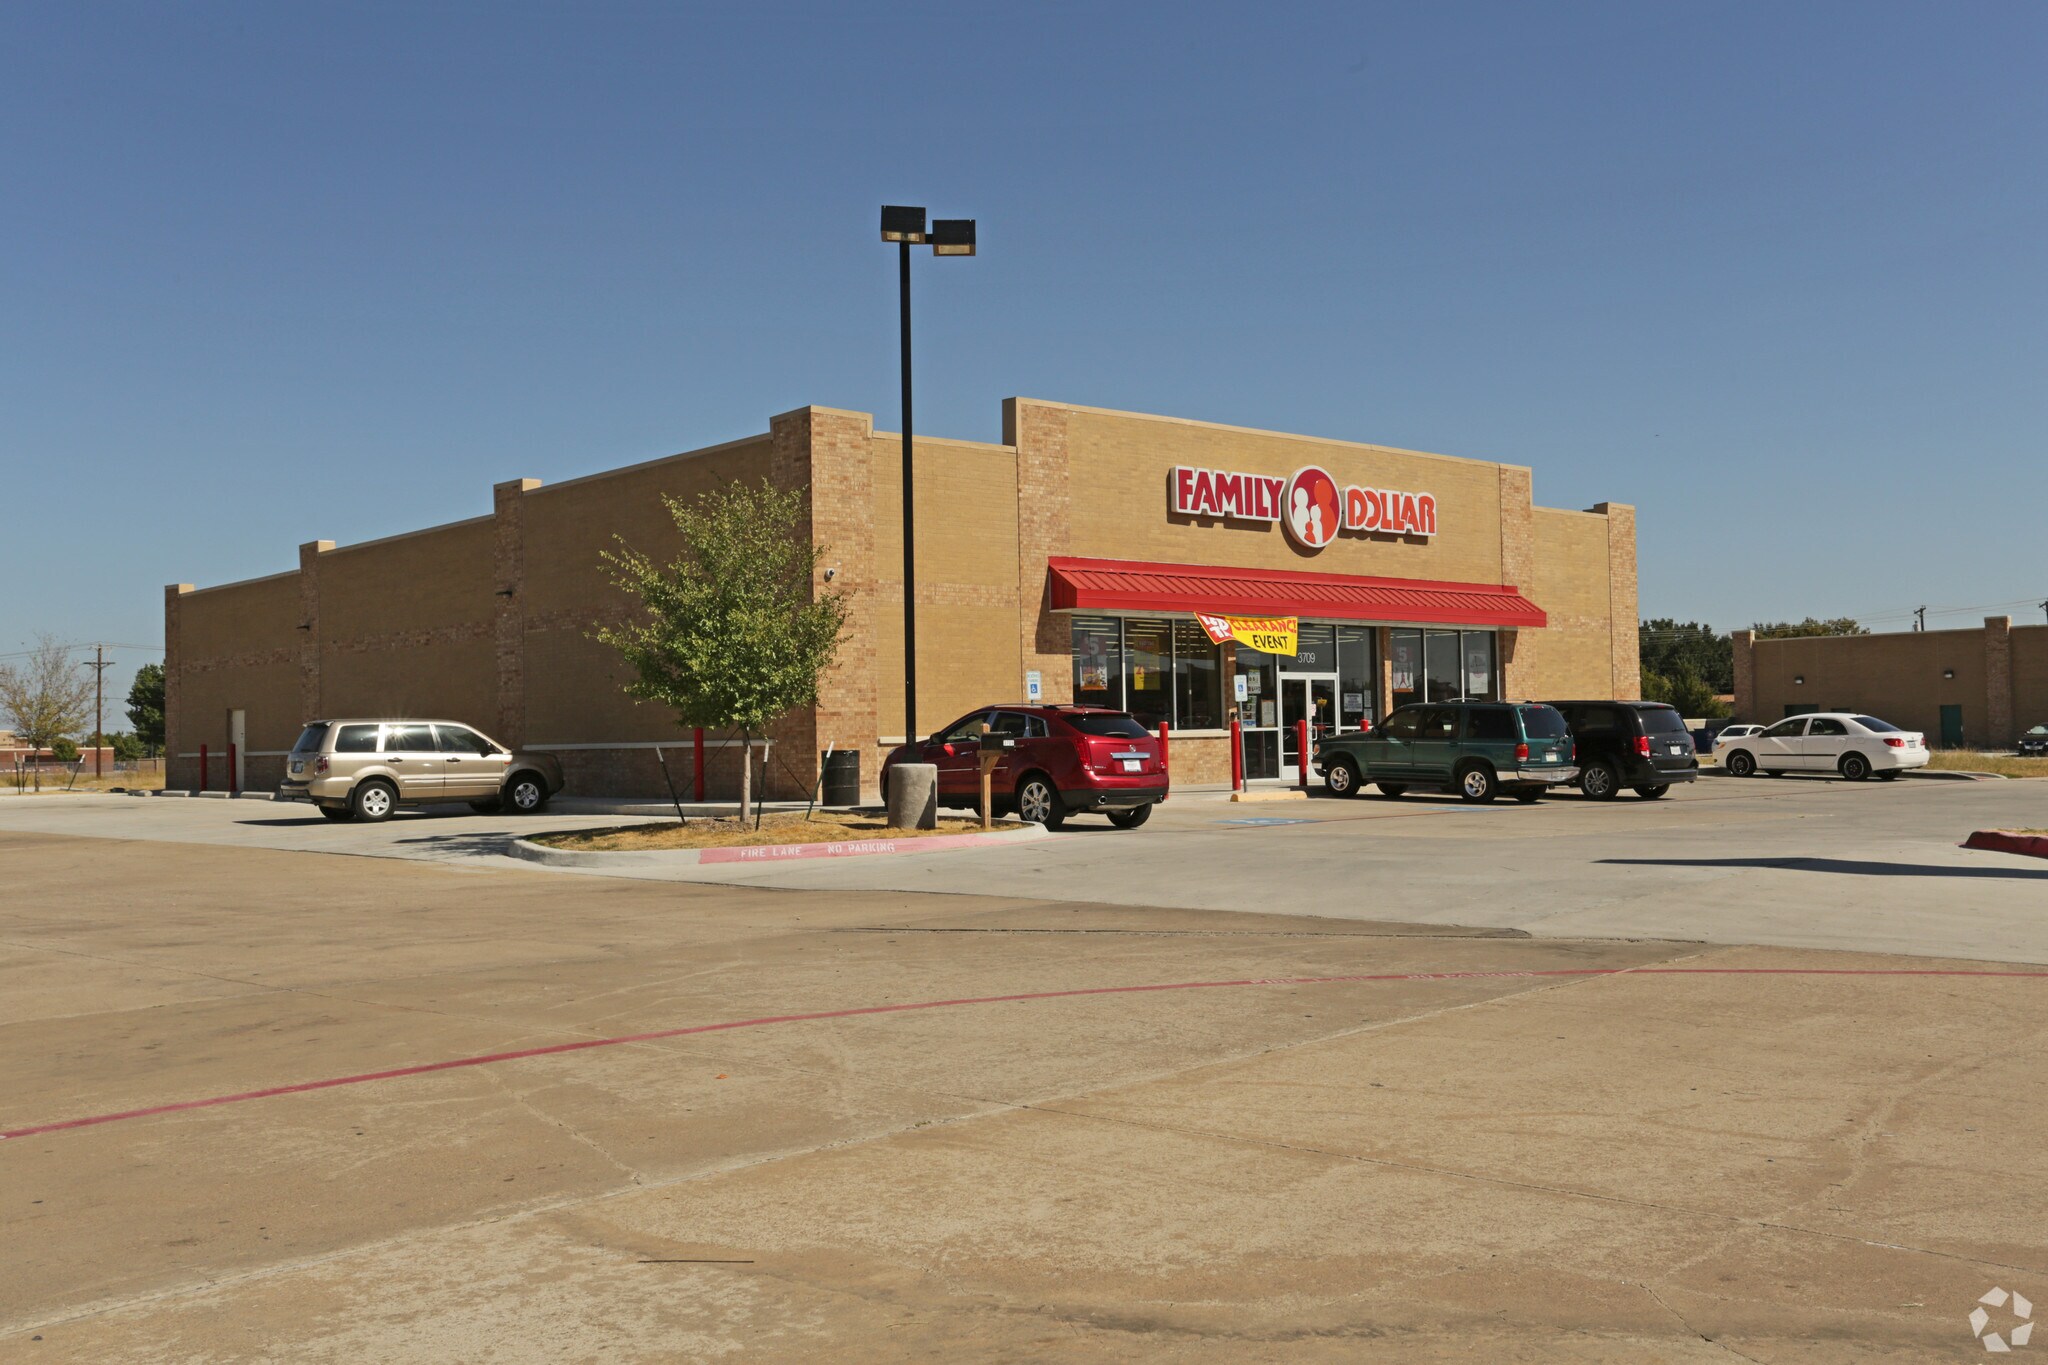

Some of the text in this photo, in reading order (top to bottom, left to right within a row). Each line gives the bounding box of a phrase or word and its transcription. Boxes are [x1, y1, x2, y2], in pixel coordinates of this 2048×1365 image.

[1177, 468, 1436, 534] FAMILY DOLLAR
[1252, 634, 1288, 650] EVENT
[1297, 652, 1316, 664] 3709
[740, 842, 896, 858] FIRE LANE NO PARKING
